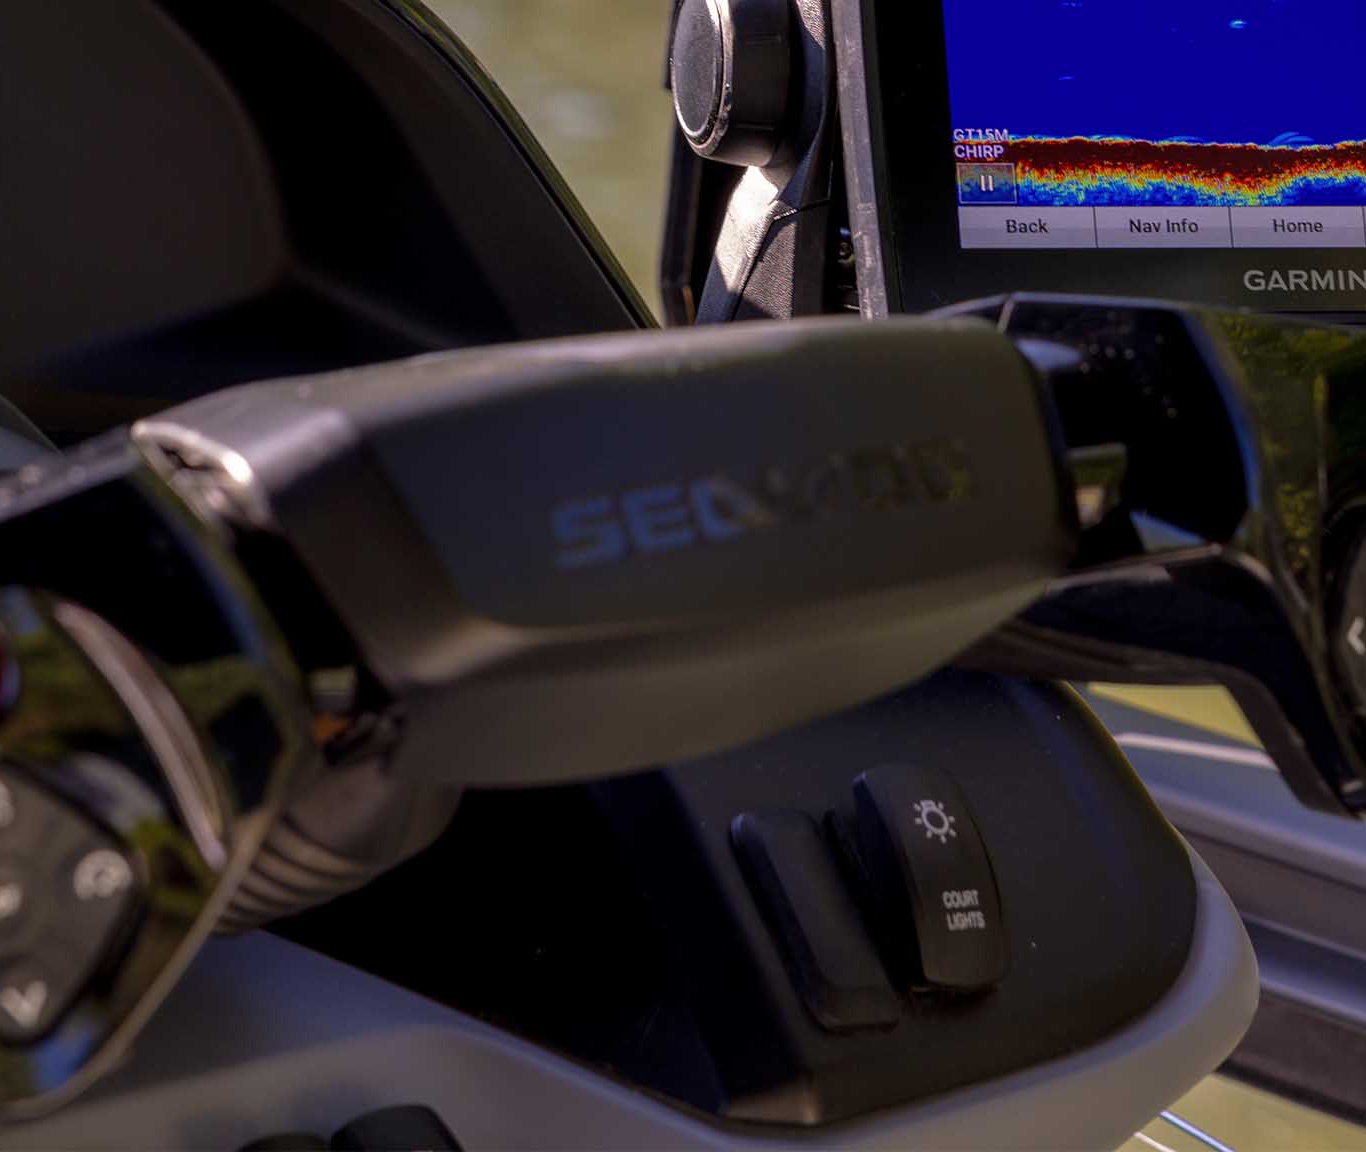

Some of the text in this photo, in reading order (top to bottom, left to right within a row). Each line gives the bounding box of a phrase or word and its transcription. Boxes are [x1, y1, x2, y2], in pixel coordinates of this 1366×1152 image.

[954, 144, 1004, 159] CHIRP
[1005, 219, 1049, 234] Back
[1129, 219, 1199, 234] Nav Info
[1272, 218, 1323, 233] Home
[942, 889, 979, 909] COURT
[946, 911, 986, 931] LIGHTS
